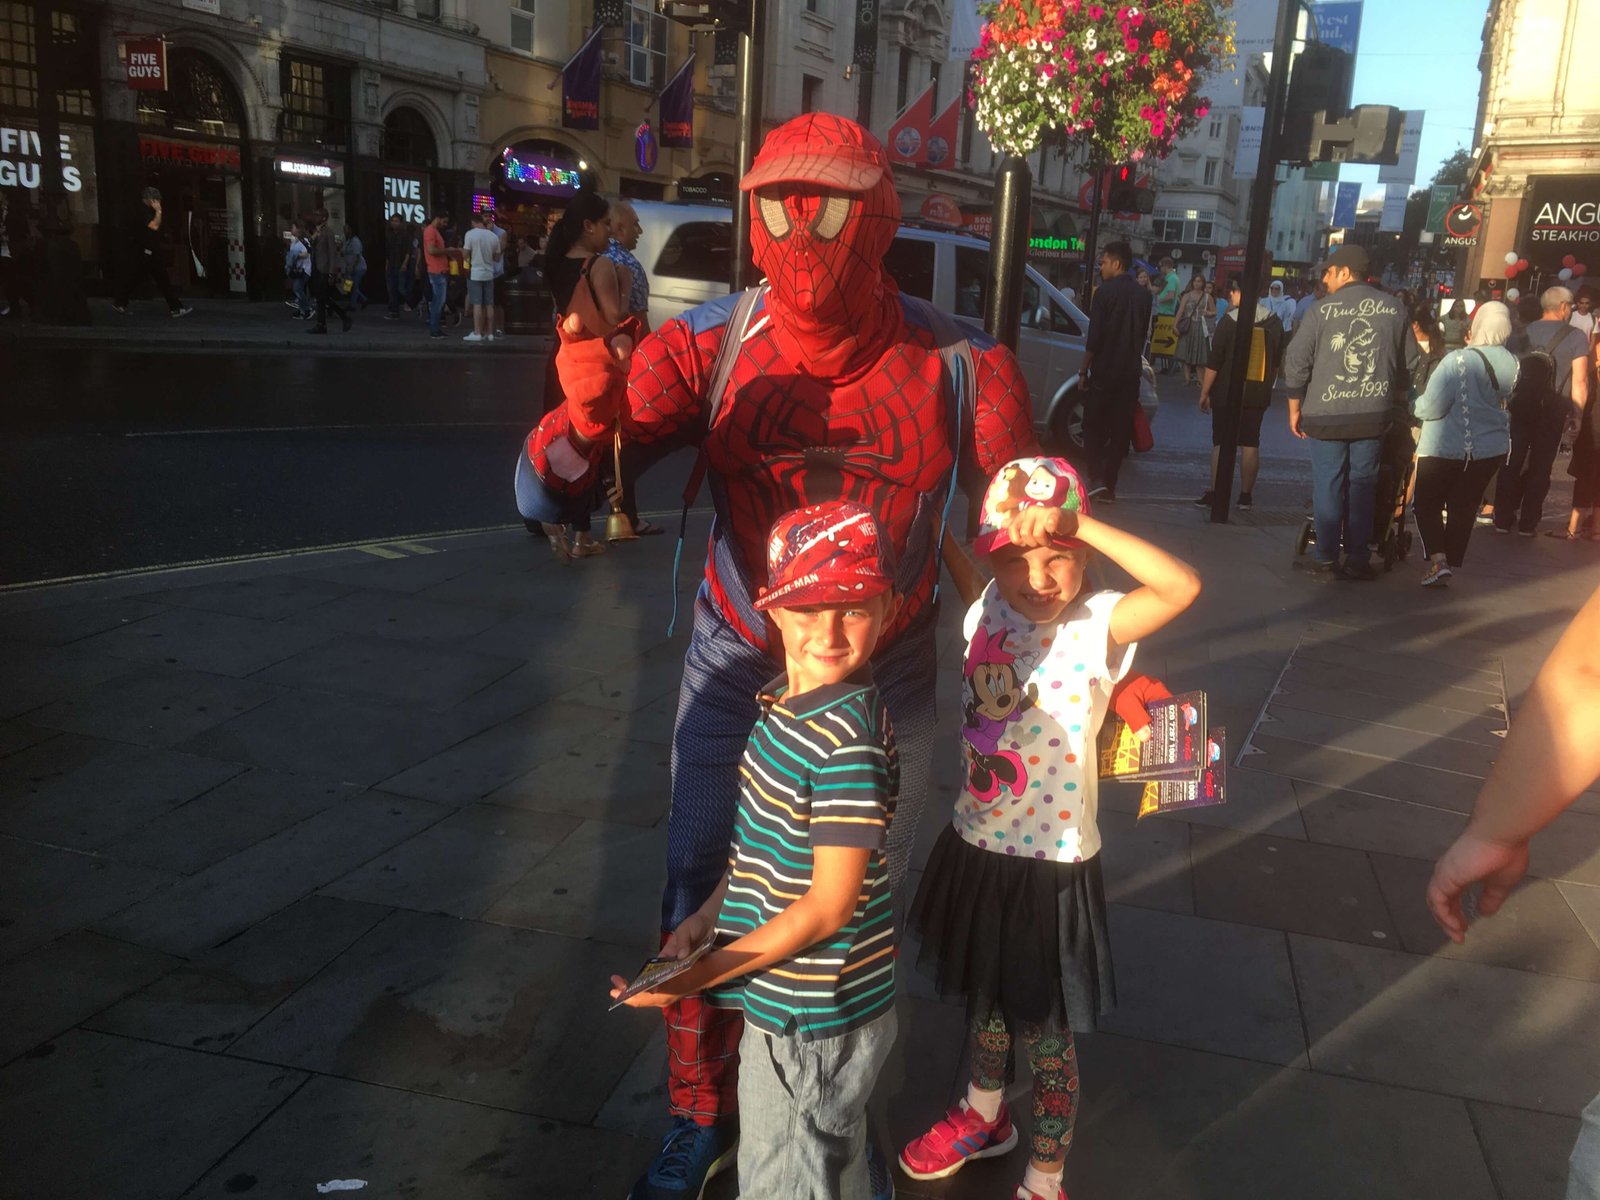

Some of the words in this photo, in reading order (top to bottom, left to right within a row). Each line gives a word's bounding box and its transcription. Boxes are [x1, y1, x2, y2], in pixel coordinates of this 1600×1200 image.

[130, 52, 157, 65] FIVE
[128, 65, 161, 78] GUYS
[0, 159, 82, 192] GUS
[383, 176, 421, 200] FIVE
[1534, 202, 1600, 226] ANG
[1444, 236, 1477, 246] ANGUS
[1531, 228, 1600, 242] STEAKHO
[1320, 301, 1357, 320] True
[1357, 298, 1398, 317] Blue
[1321, 383, 1359, 402] Since
[1359, 380, 1390, 398] 1993
[756, 573, 819, 608] SPIDER-MAN
